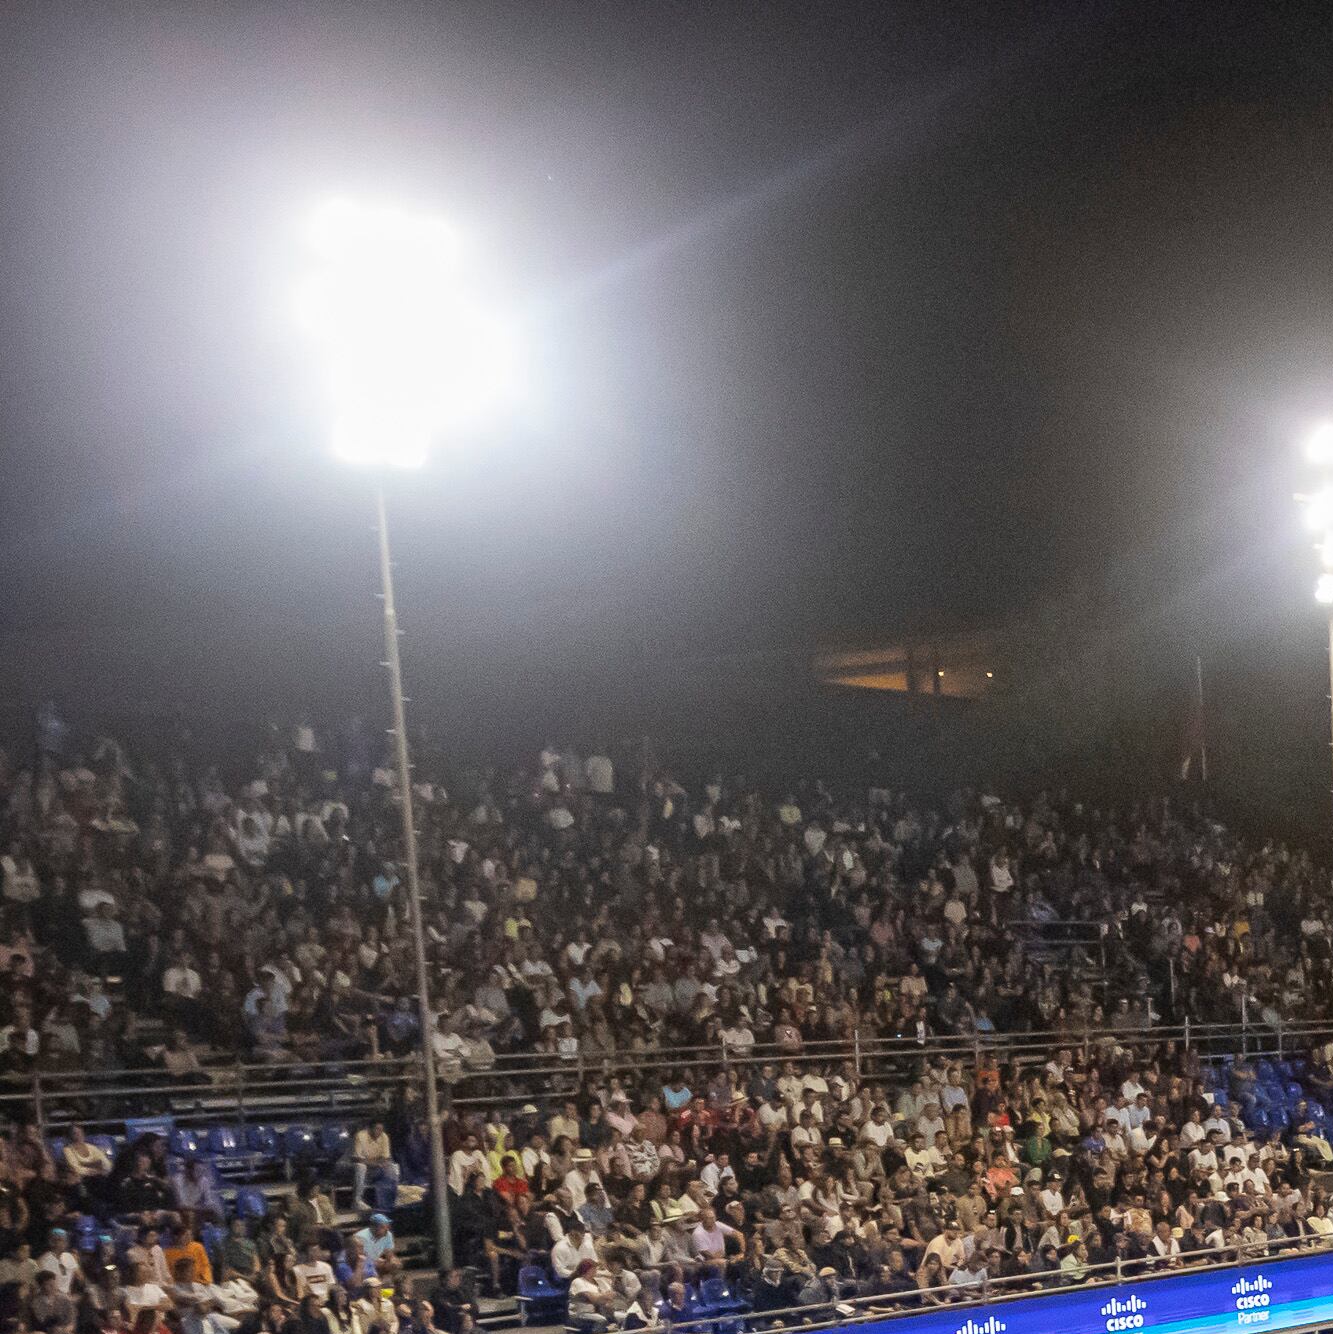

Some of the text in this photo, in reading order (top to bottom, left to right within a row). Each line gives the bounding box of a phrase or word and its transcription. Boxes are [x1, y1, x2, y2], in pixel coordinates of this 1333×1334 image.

[1236, 1294, 1270, 1310] CISCO
[1106, 1314, 1144, 1332] CISCO
[1238, 1310, 1270, 1325] Partner
